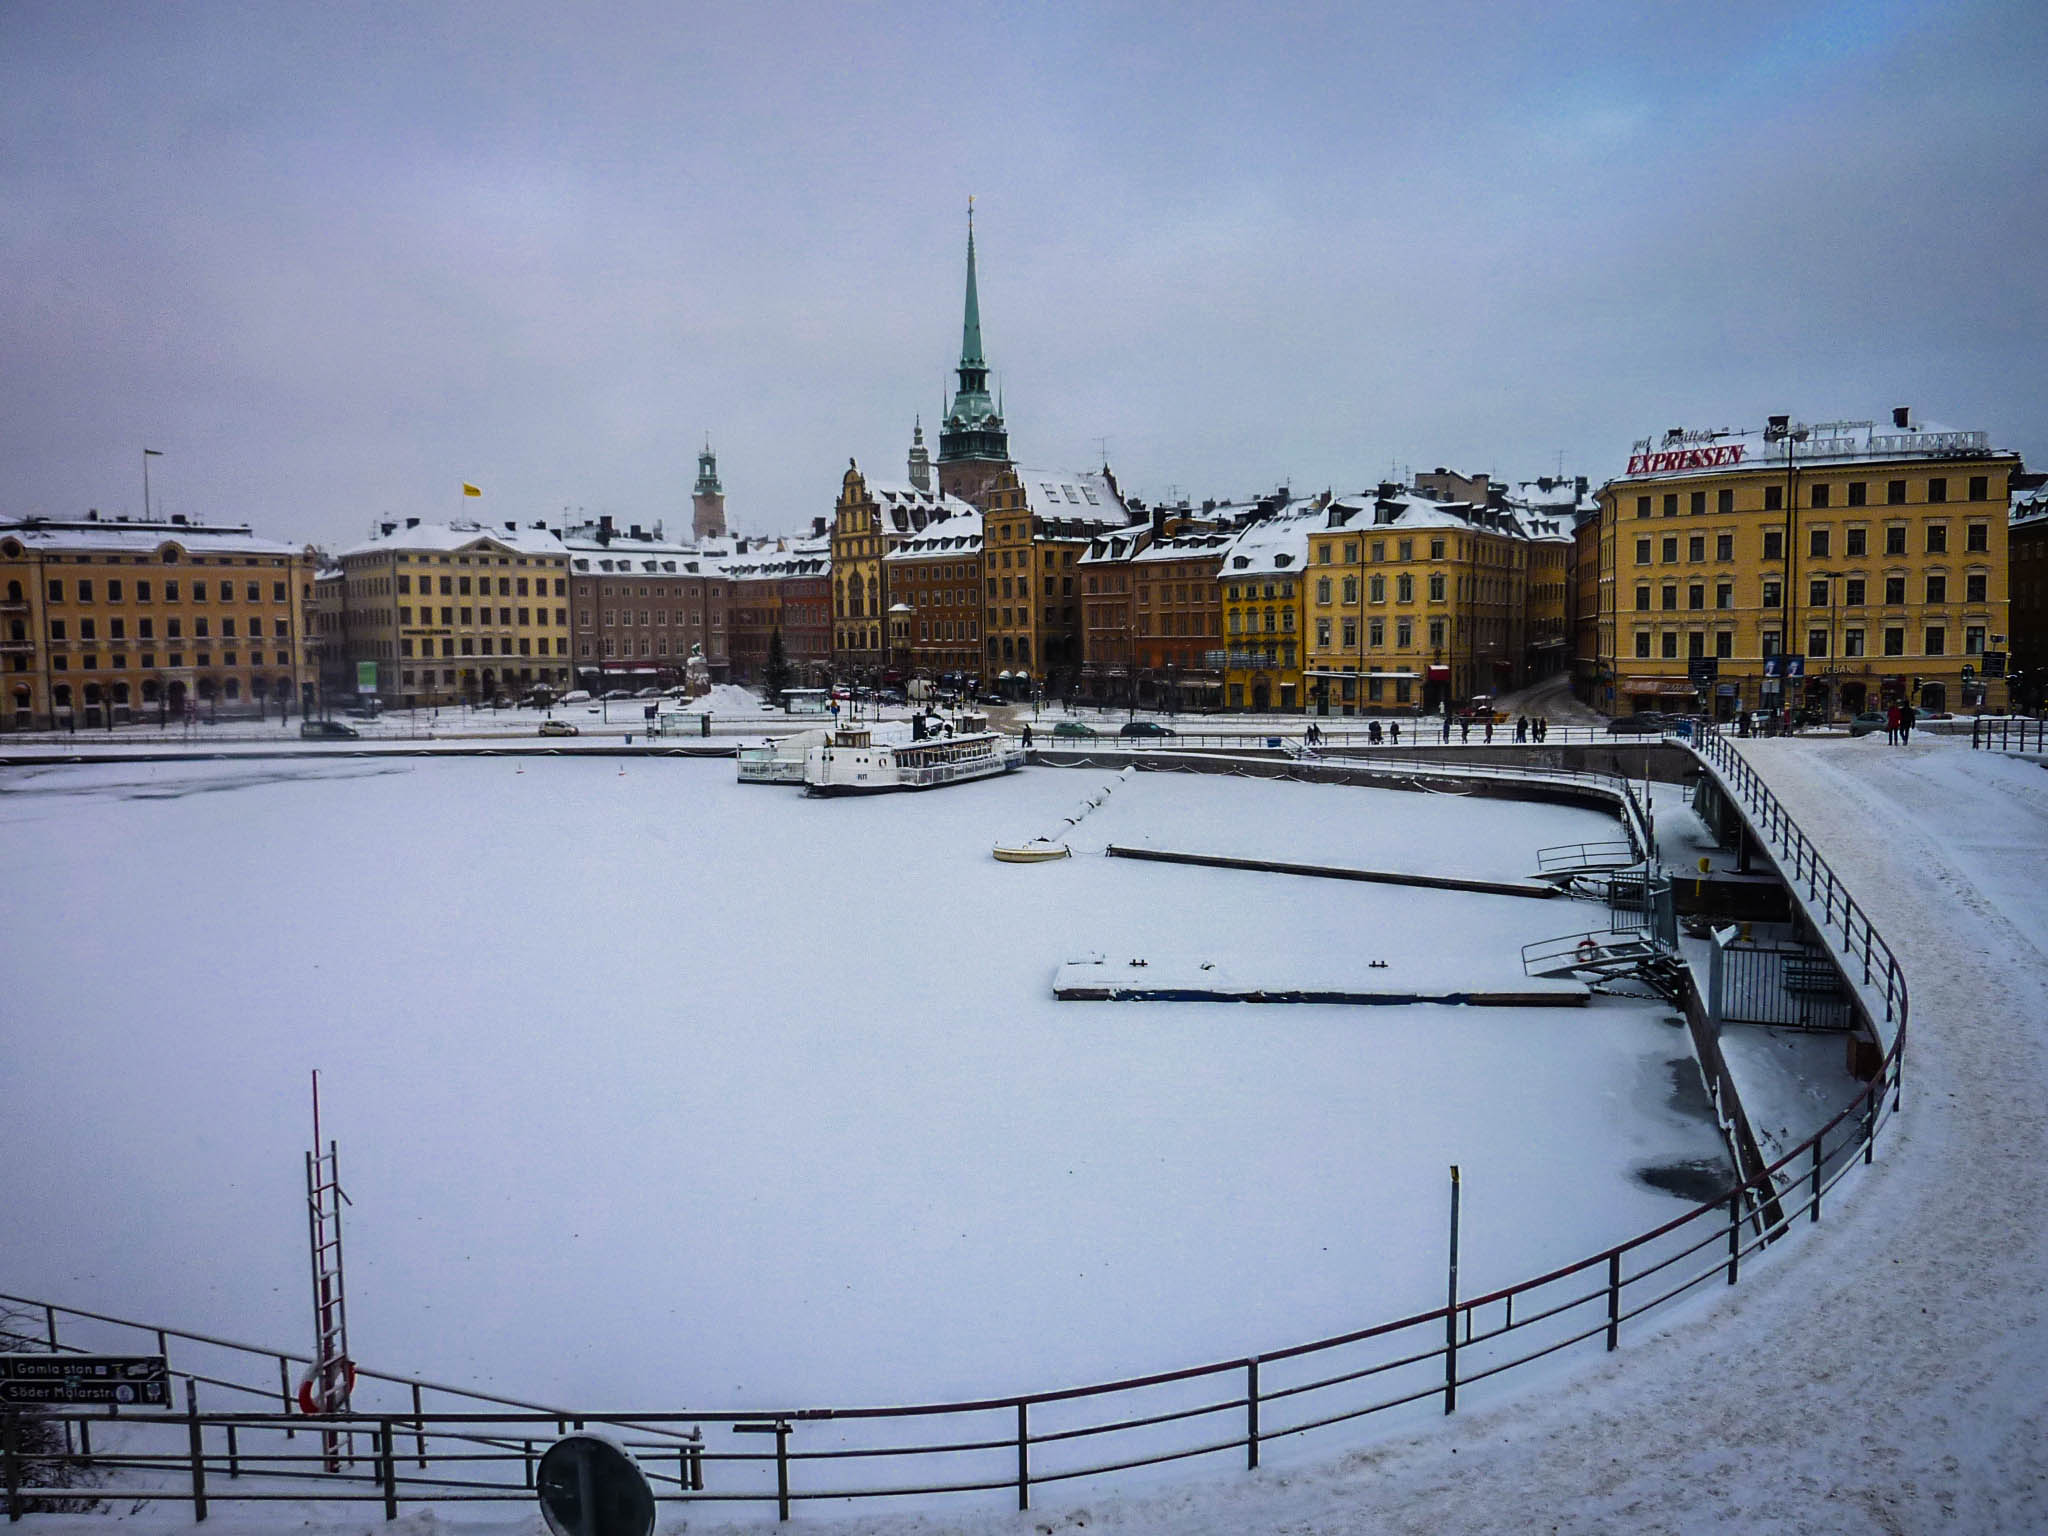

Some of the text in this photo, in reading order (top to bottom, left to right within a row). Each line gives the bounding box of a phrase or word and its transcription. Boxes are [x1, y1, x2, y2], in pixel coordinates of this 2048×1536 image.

[1625, 444, 1745, 474] EXPRESSEN
[16, 1363, 93, 1374] Gamla stan
[9, 1386, 115, 1399] Söder Mälarstr
